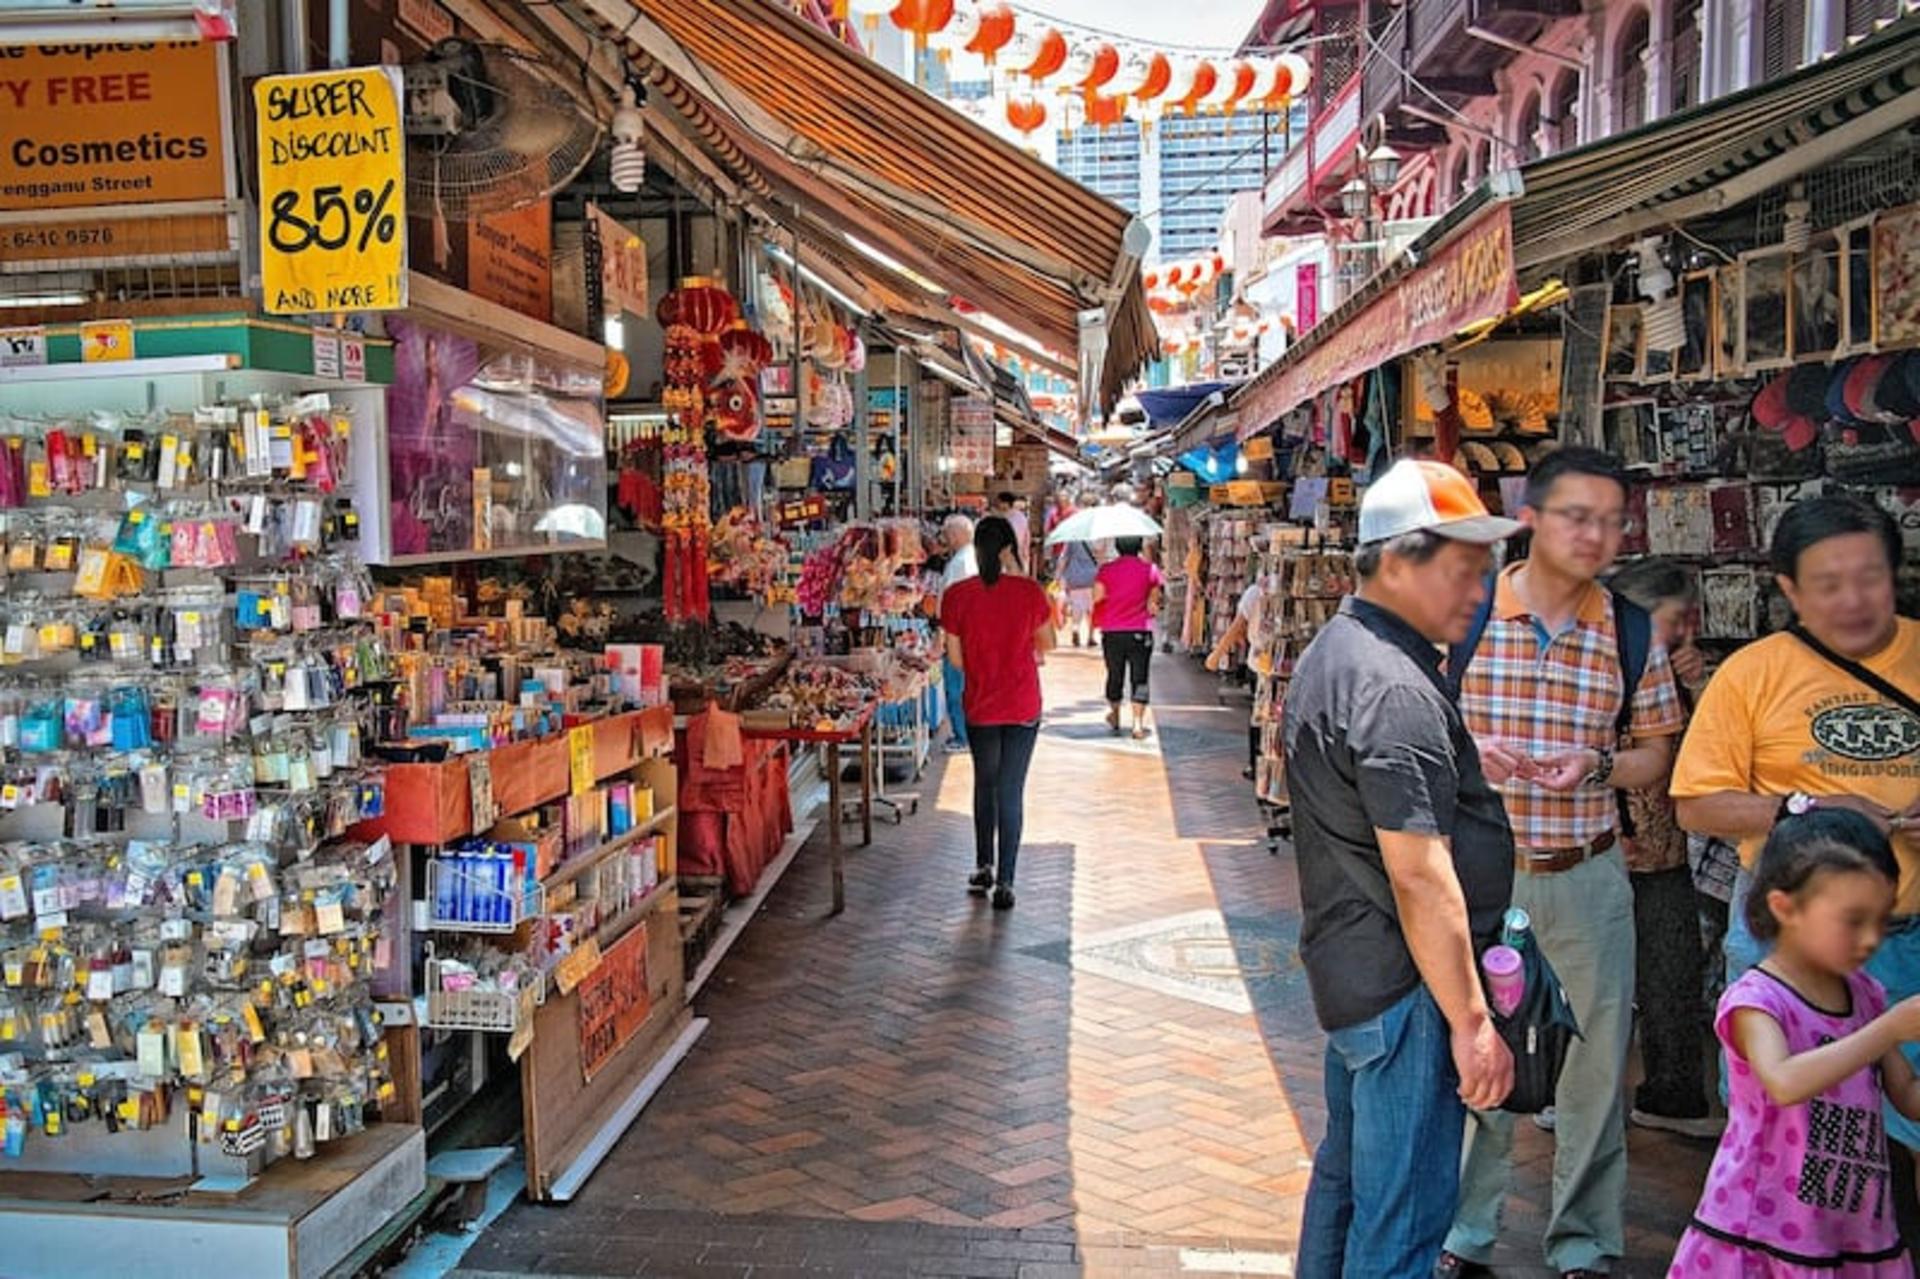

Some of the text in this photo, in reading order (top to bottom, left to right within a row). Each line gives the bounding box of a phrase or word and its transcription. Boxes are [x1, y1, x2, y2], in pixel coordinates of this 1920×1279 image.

[48, 73, 152, 105] FREE
[268, 79, 375, 121] SUPER
[12, 132, 208, 167] Cosmetics
[0, 175, 154, 197] engganu Street
[268, 179, 395, 252] 85%
[276, 289, 317, 310] AND
[328, 285, 375, 307] MORE
